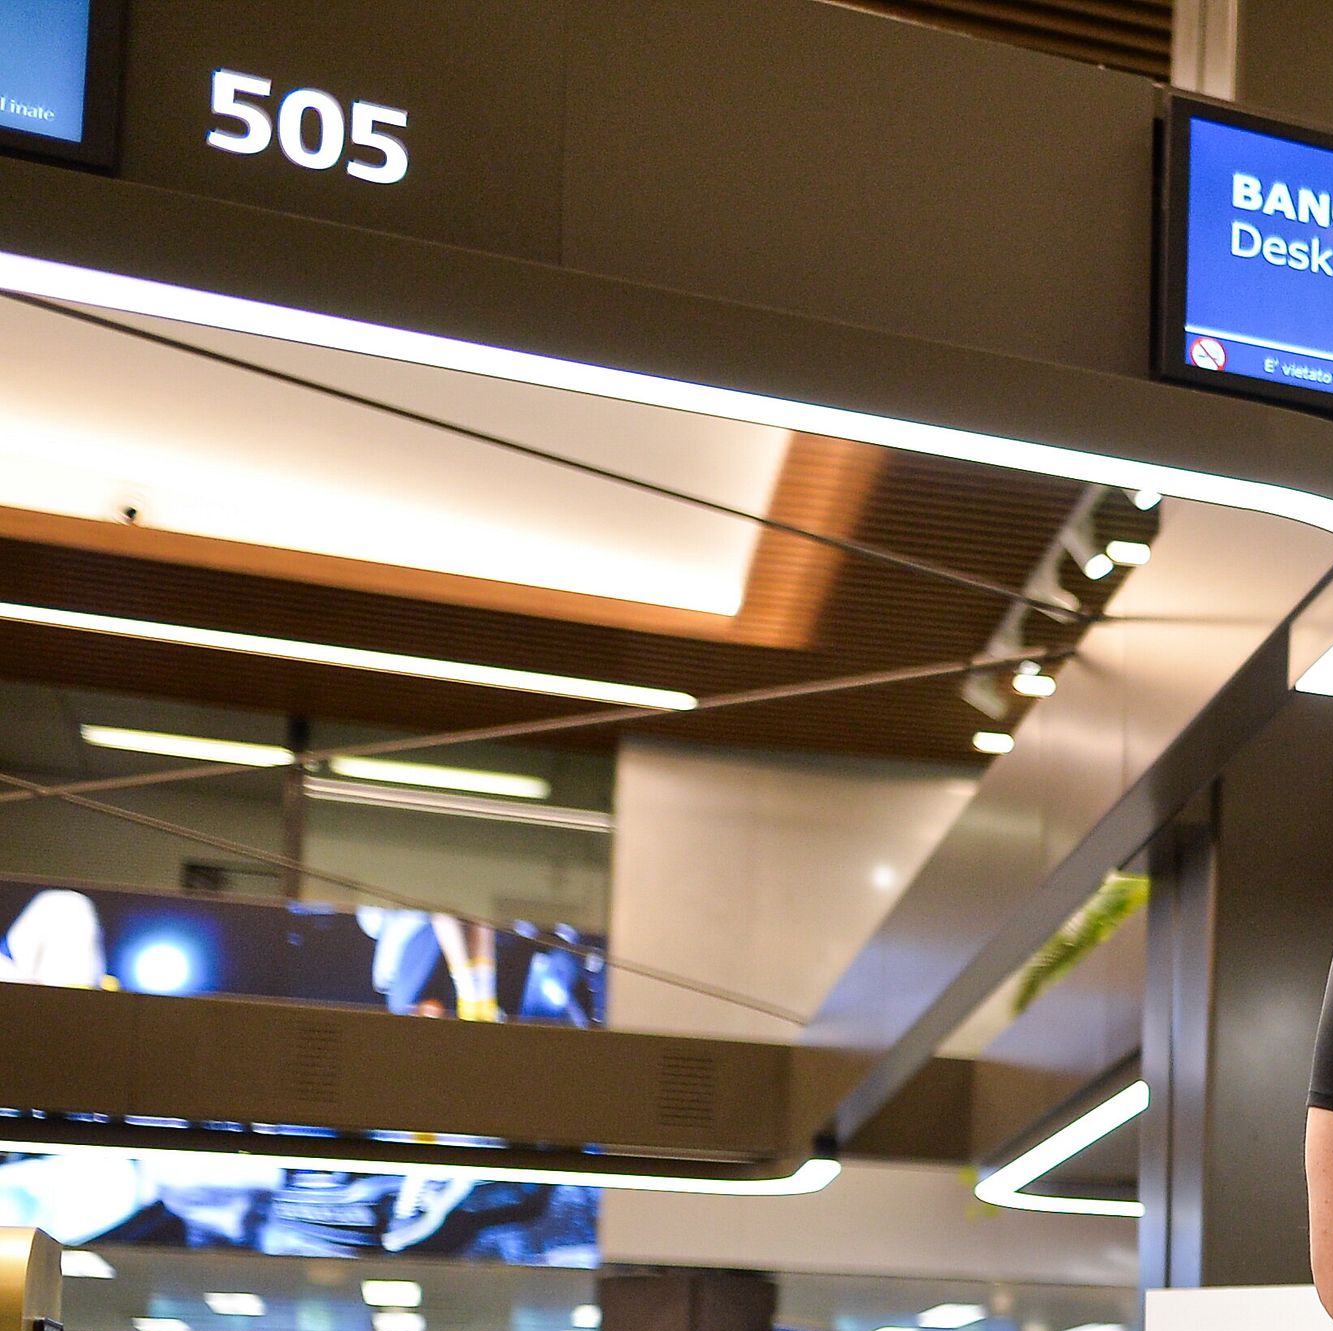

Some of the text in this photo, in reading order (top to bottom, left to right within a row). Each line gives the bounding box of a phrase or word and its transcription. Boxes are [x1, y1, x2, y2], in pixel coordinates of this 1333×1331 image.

[206, 68, 408, 184] 505
[1231, 221, 1333, 277] Desk
[1282, 361, 1331, 384] vietato
